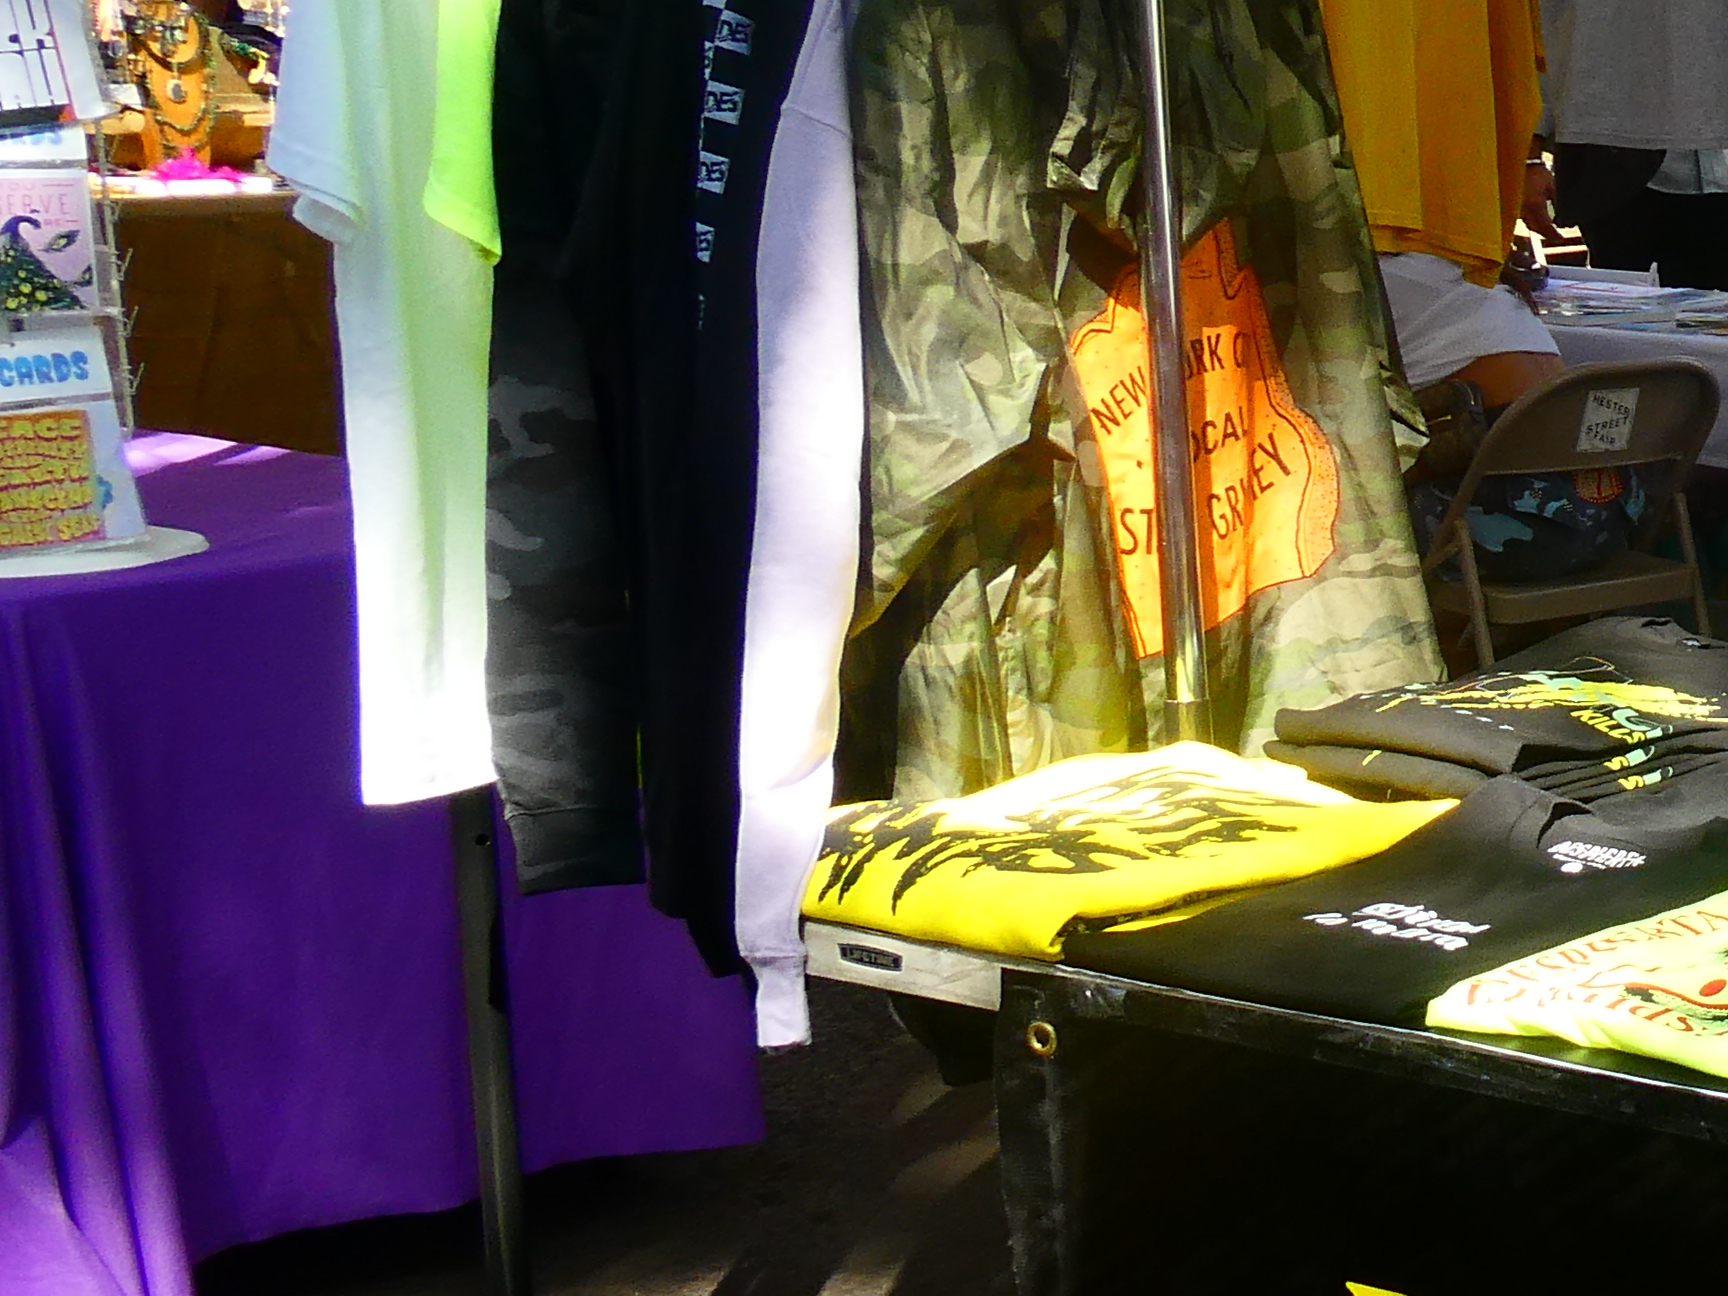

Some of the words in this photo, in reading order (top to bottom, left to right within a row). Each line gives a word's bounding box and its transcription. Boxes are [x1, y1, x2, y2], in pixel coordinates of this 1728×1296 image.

[1090, 365, 1148, 436] NEW
[1186, 332, 1225, 380] RK
[1593, 394, 1631, 416] HESTER
[1190, 406, 1249, 462] CAL
[1585, 415, 1629, 435] STREET
[1120, 507, 1156, 556] ST
